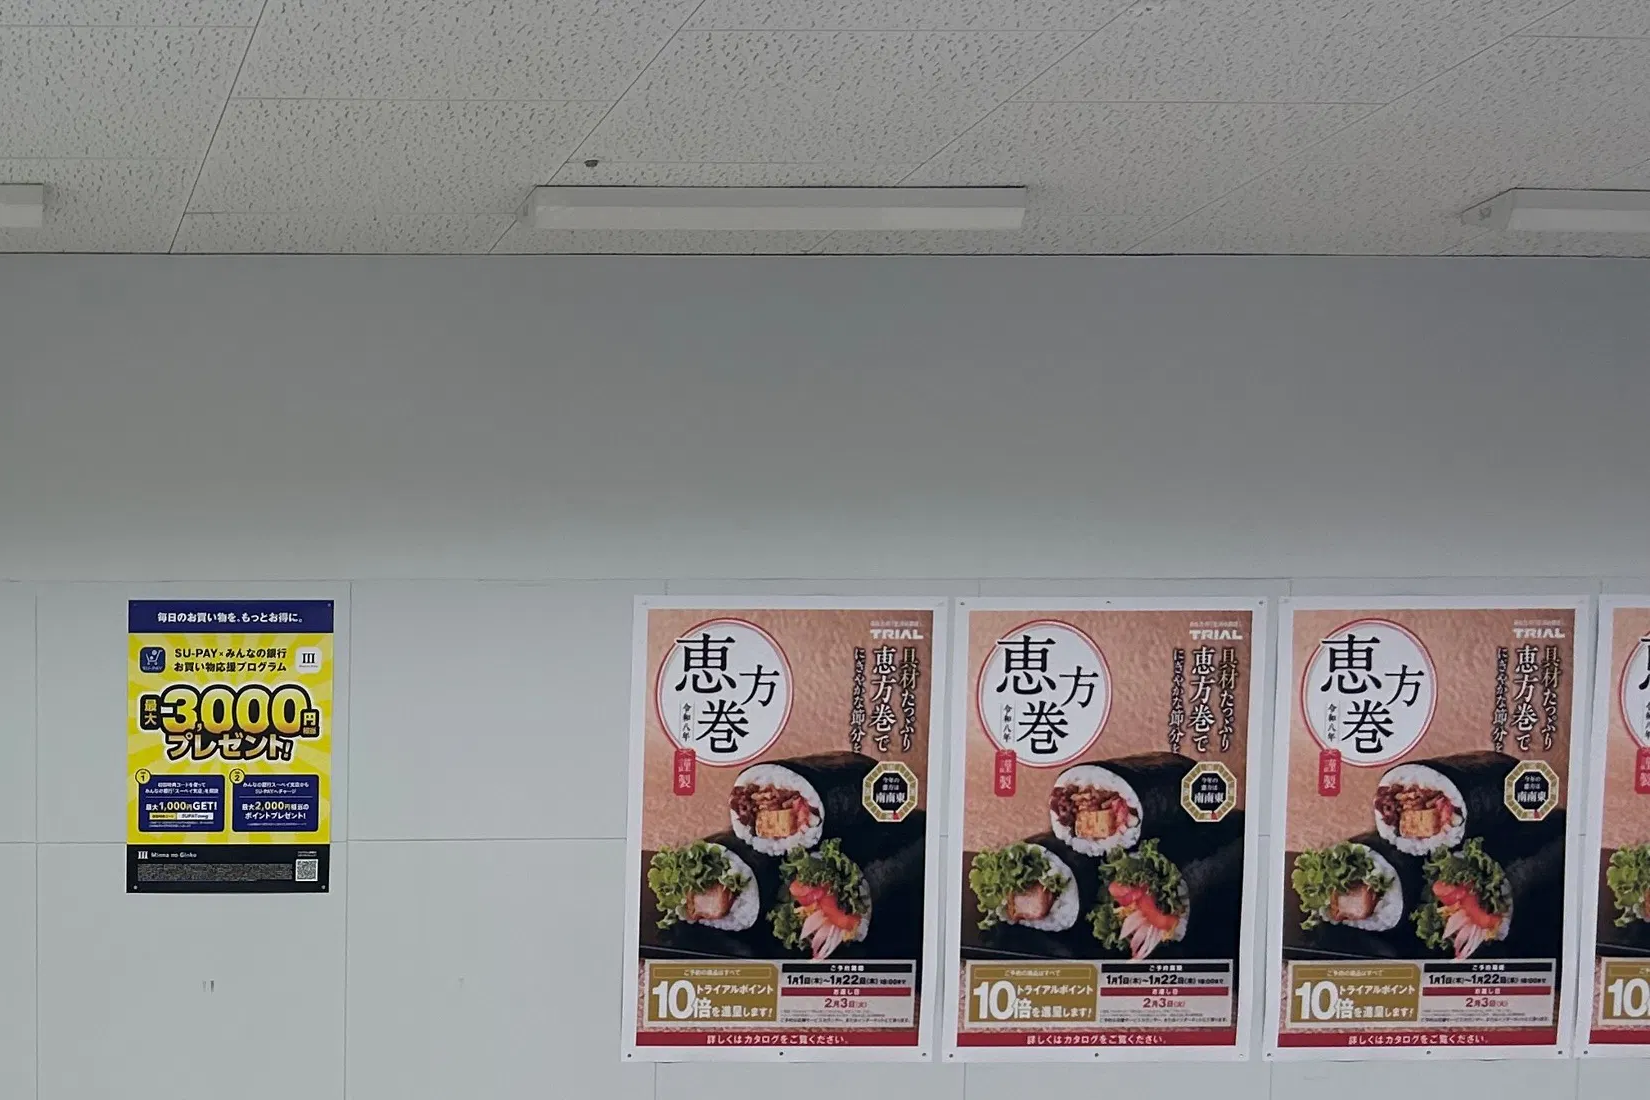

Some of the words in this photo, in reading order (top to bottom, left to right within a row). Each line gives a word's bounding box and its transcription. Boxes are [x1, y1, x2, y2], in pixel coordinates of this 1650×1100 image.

[158, 612, 303, 623] 毎日のお買い物を。もっとお得に。
[870, 629, 923, 639] TRIAL
[1189, 629, 1243, 640] TRIAL
[1512, 628, 1565, 639] TRIAL
[174, 662, 287, 672] お買い物応援プログラム
[675, 633, 780, 753] 恵方巻
[870, 646, 897, 751] 恵方巻で
[900, 648, 919, 751] 具材たっぷり
[996, 635, 1099, 754] 恵方巻
[1189, 646, 1216, 752] 恵方巻で
[1219, 648, 1238, 751] 具材たっぷり
[1321, 633, 1425, 753] 恵方巻
[1512, 645, 1539, 750] 恵方巻で
[1542, 647, 1560, 750] 具材たっぷり
[144, 699, 157, 725] 最大
[162, 688, 308, 734] 3,000
[303, 712, 316, 726] 円
[682, 703, 692, 742] 令和八年
[1003, 704, 1012, 742] 令和八年
[167, 732, 292, 759] プレゼント!
[876, 792, 906, 803] 南南東
[1194, 792, 1224, 804] 南南東
[245, 812, 306, 820] ポイントプレゼント!
[697, 984, 774, 995] トライアルポイント
[1017, 985, 1093, 995] トライアルポイント
[1340, 985, 1416, 995] トライアルポイント
[707, 1035, 848, 1045] 詳しくはカタログをご覧ください。
[1027, 1035, 1166, 1045] 詳しくはカタログをご覧ください。
